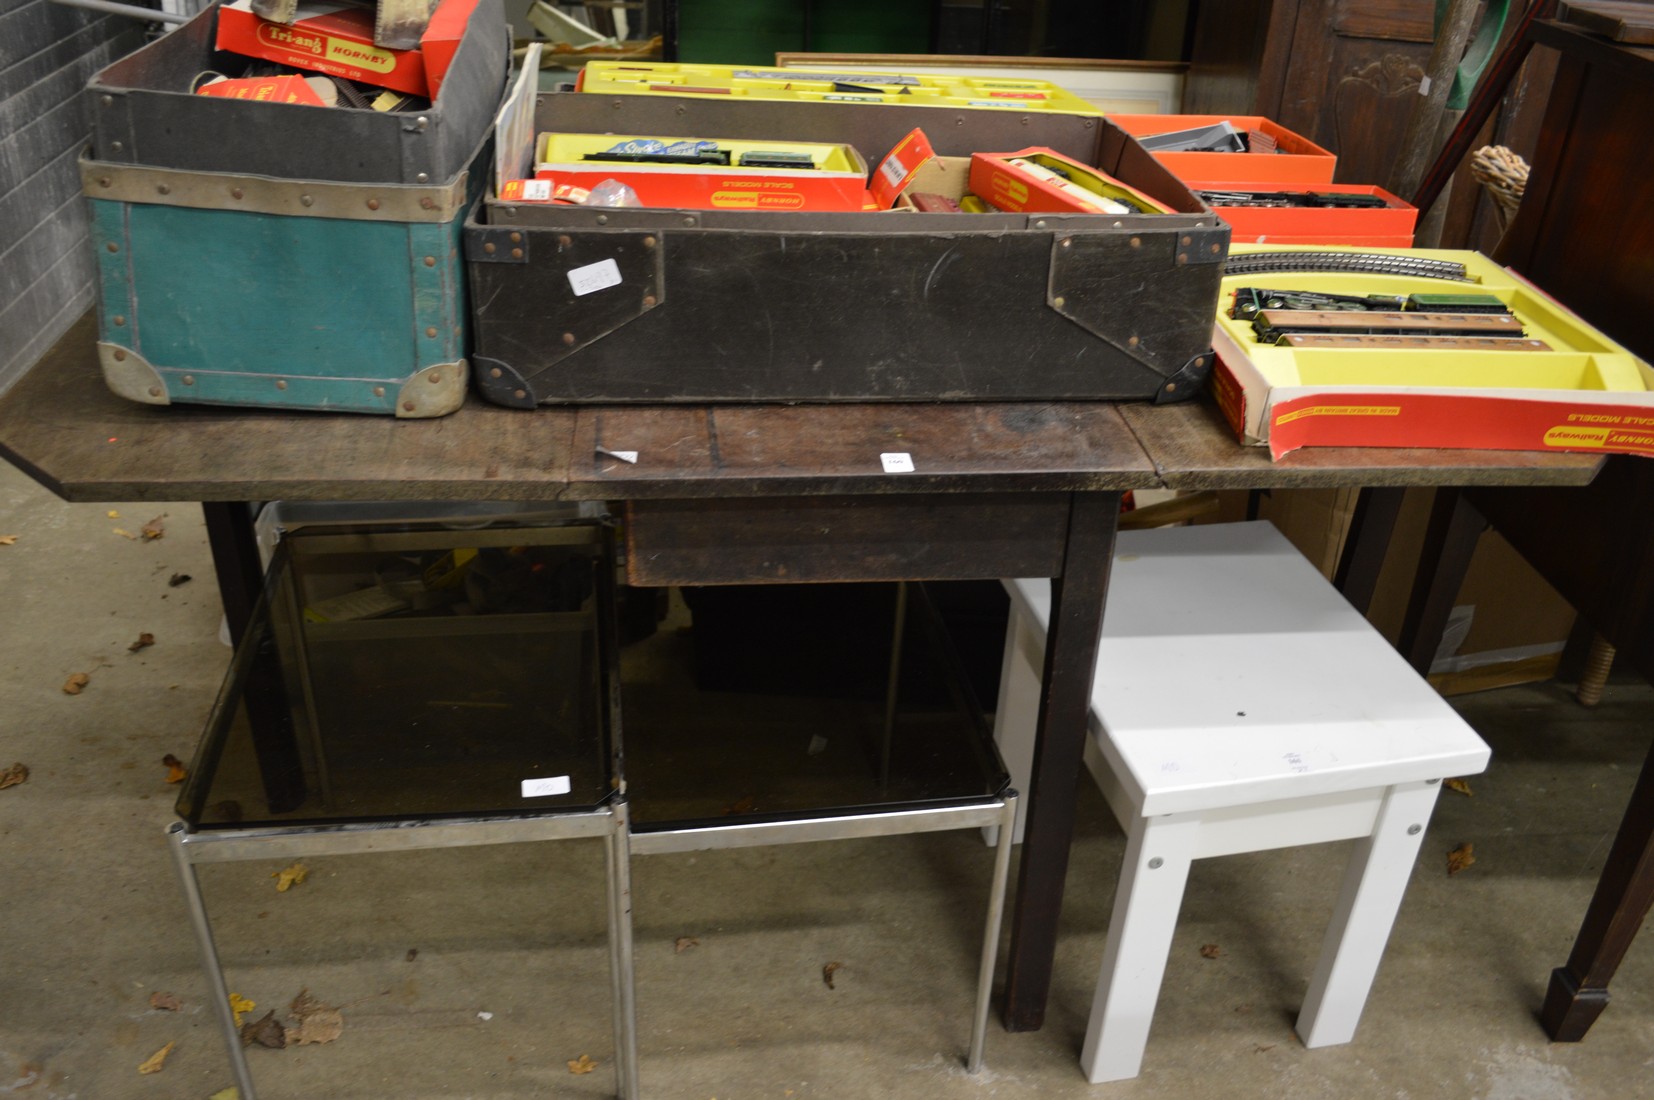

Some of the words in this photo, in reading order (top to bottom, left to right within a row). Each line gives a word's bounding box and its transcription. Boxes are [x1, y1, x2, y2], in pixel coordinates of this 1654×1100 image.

[269, 26, 322, 54] Tri-ang
[332, 45, 389, 65] HORNBY
[1566, 413, 1621, 423] MODELS
[1622, 416, 1654, 426] CALE
[1547, 432, 1604, 442] Railways
[1608, 434, 1654, 446] ORNBY
